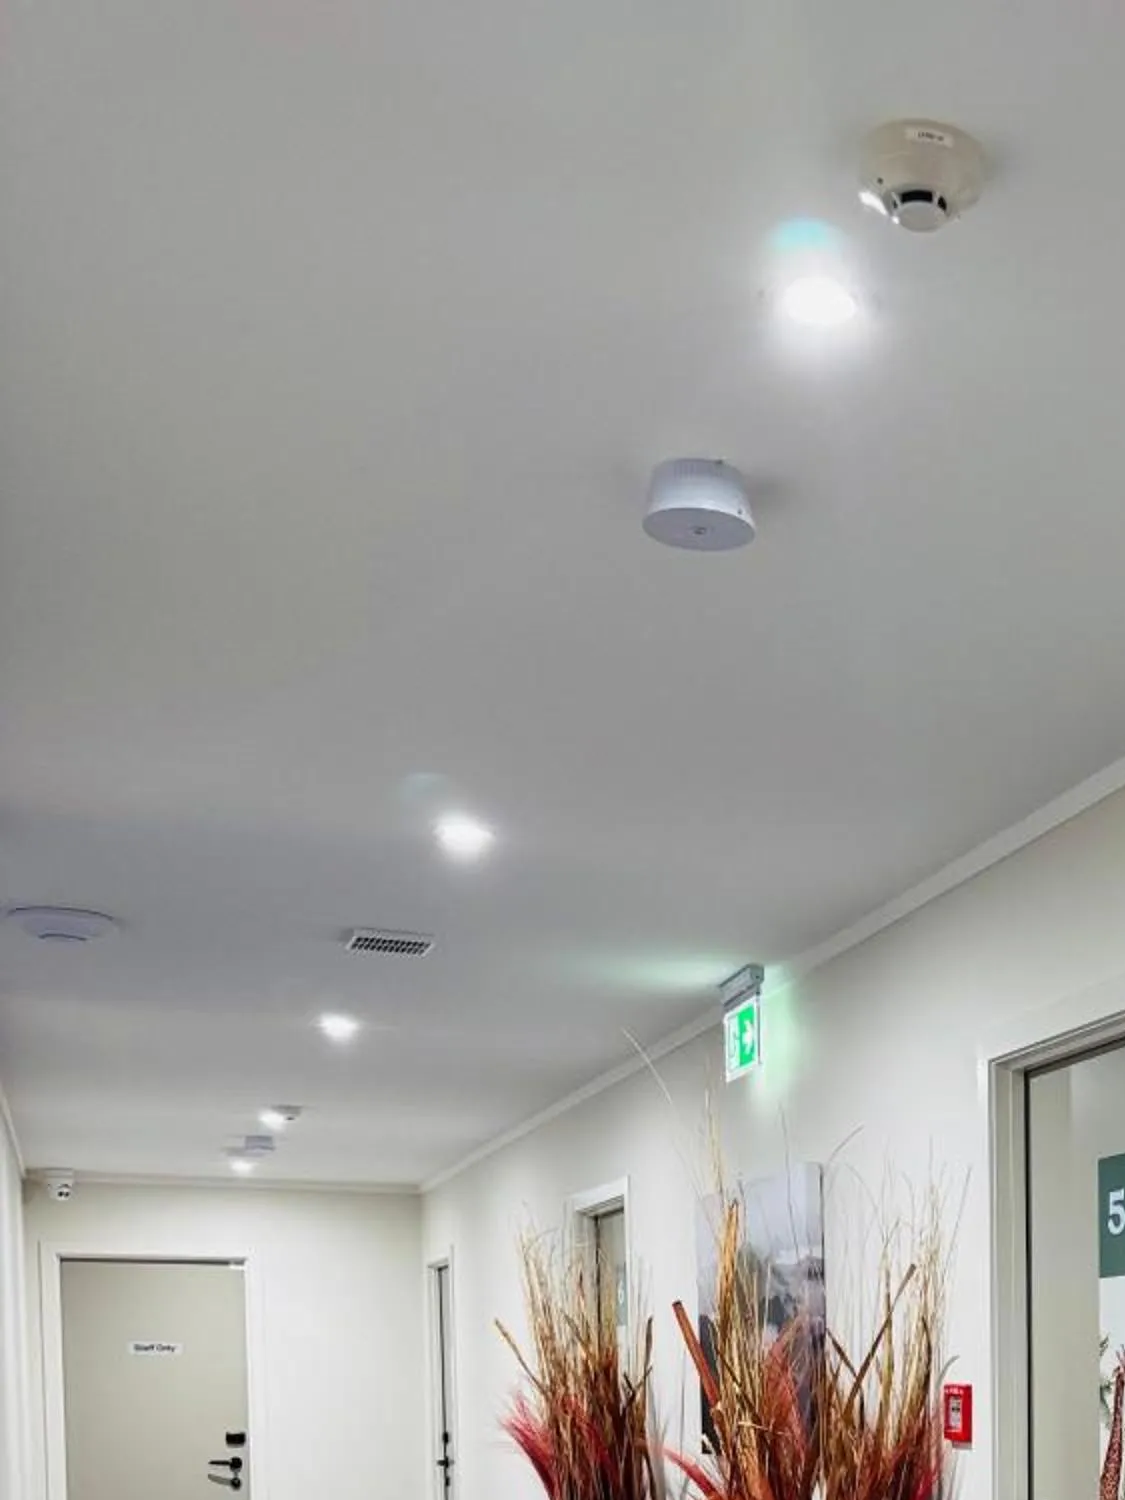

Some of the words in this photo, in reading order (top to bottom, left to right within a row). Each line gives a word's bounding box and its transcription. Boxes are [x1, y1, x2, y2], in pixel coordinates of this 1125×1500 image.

[617, 1280, 625, 1304] 6
[133, 1343, 154, 1351] Staff
[156, 1343, 176, 1353] Only
